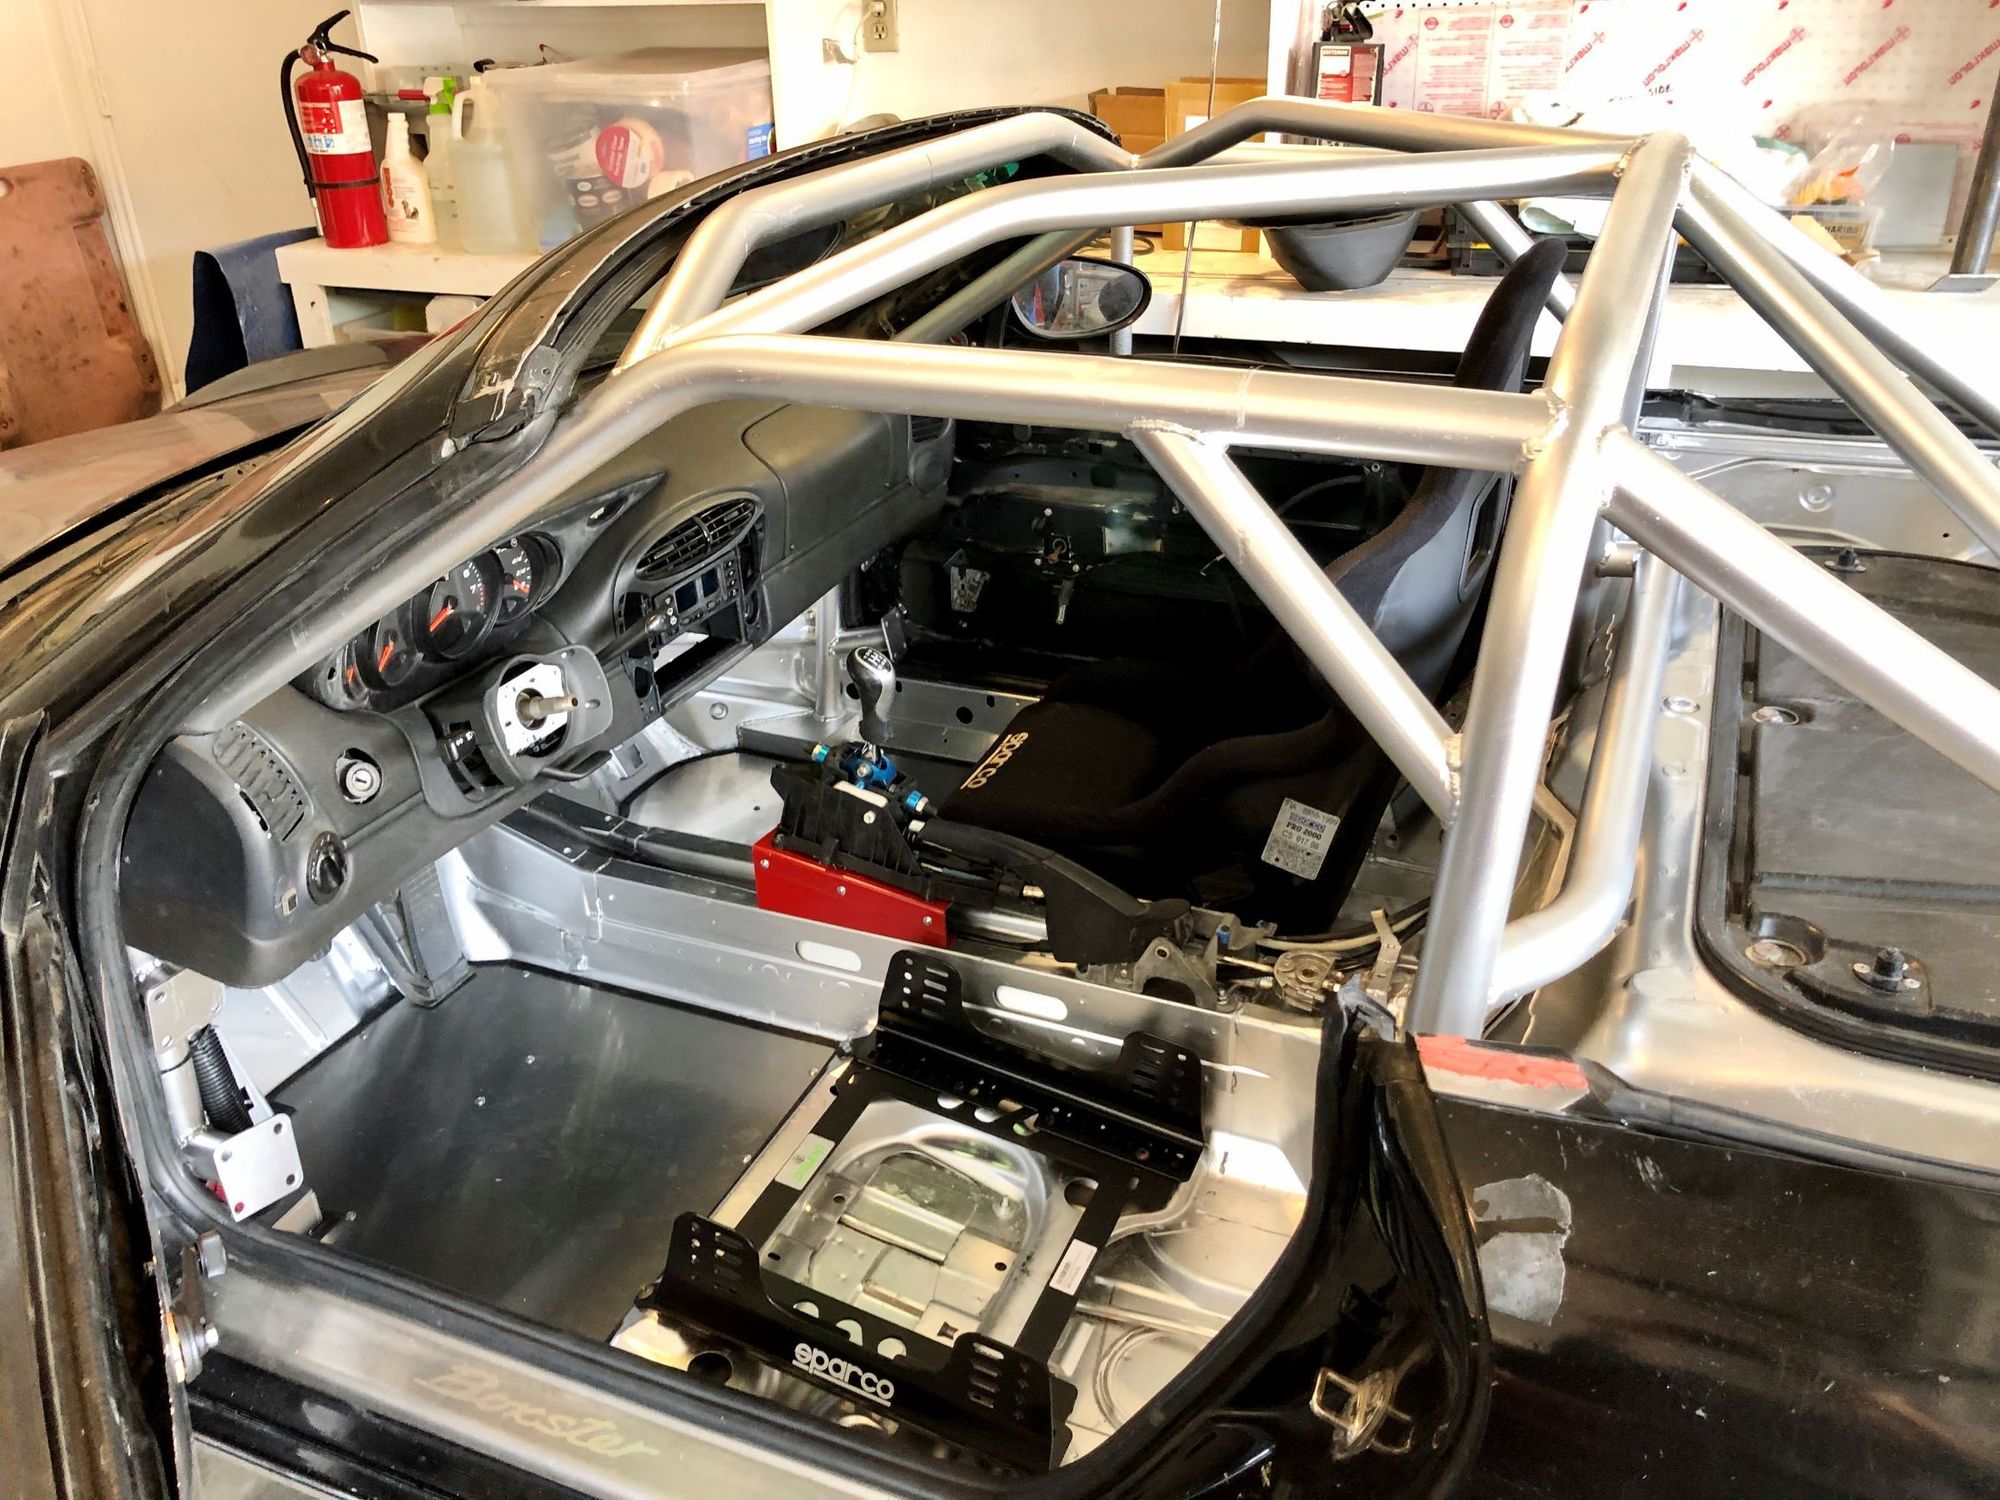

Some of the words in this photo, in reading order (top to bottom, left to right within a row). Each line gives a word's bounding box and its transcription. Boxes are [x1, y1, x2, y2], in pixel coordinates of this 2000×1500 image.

[1382, 46, 1410, 77] makro
[1565, 42, 1593, 72] makr
[470, 583, 477, 594] 7
[960, 731, 1029, 790] sparco
[1286, 821, 1303, 834] PRO
[1303, 826, 1323, 841] 2000
[793, 1342, 895, 1405] sparco
[414, 1364, 661, 1458] Boxster
